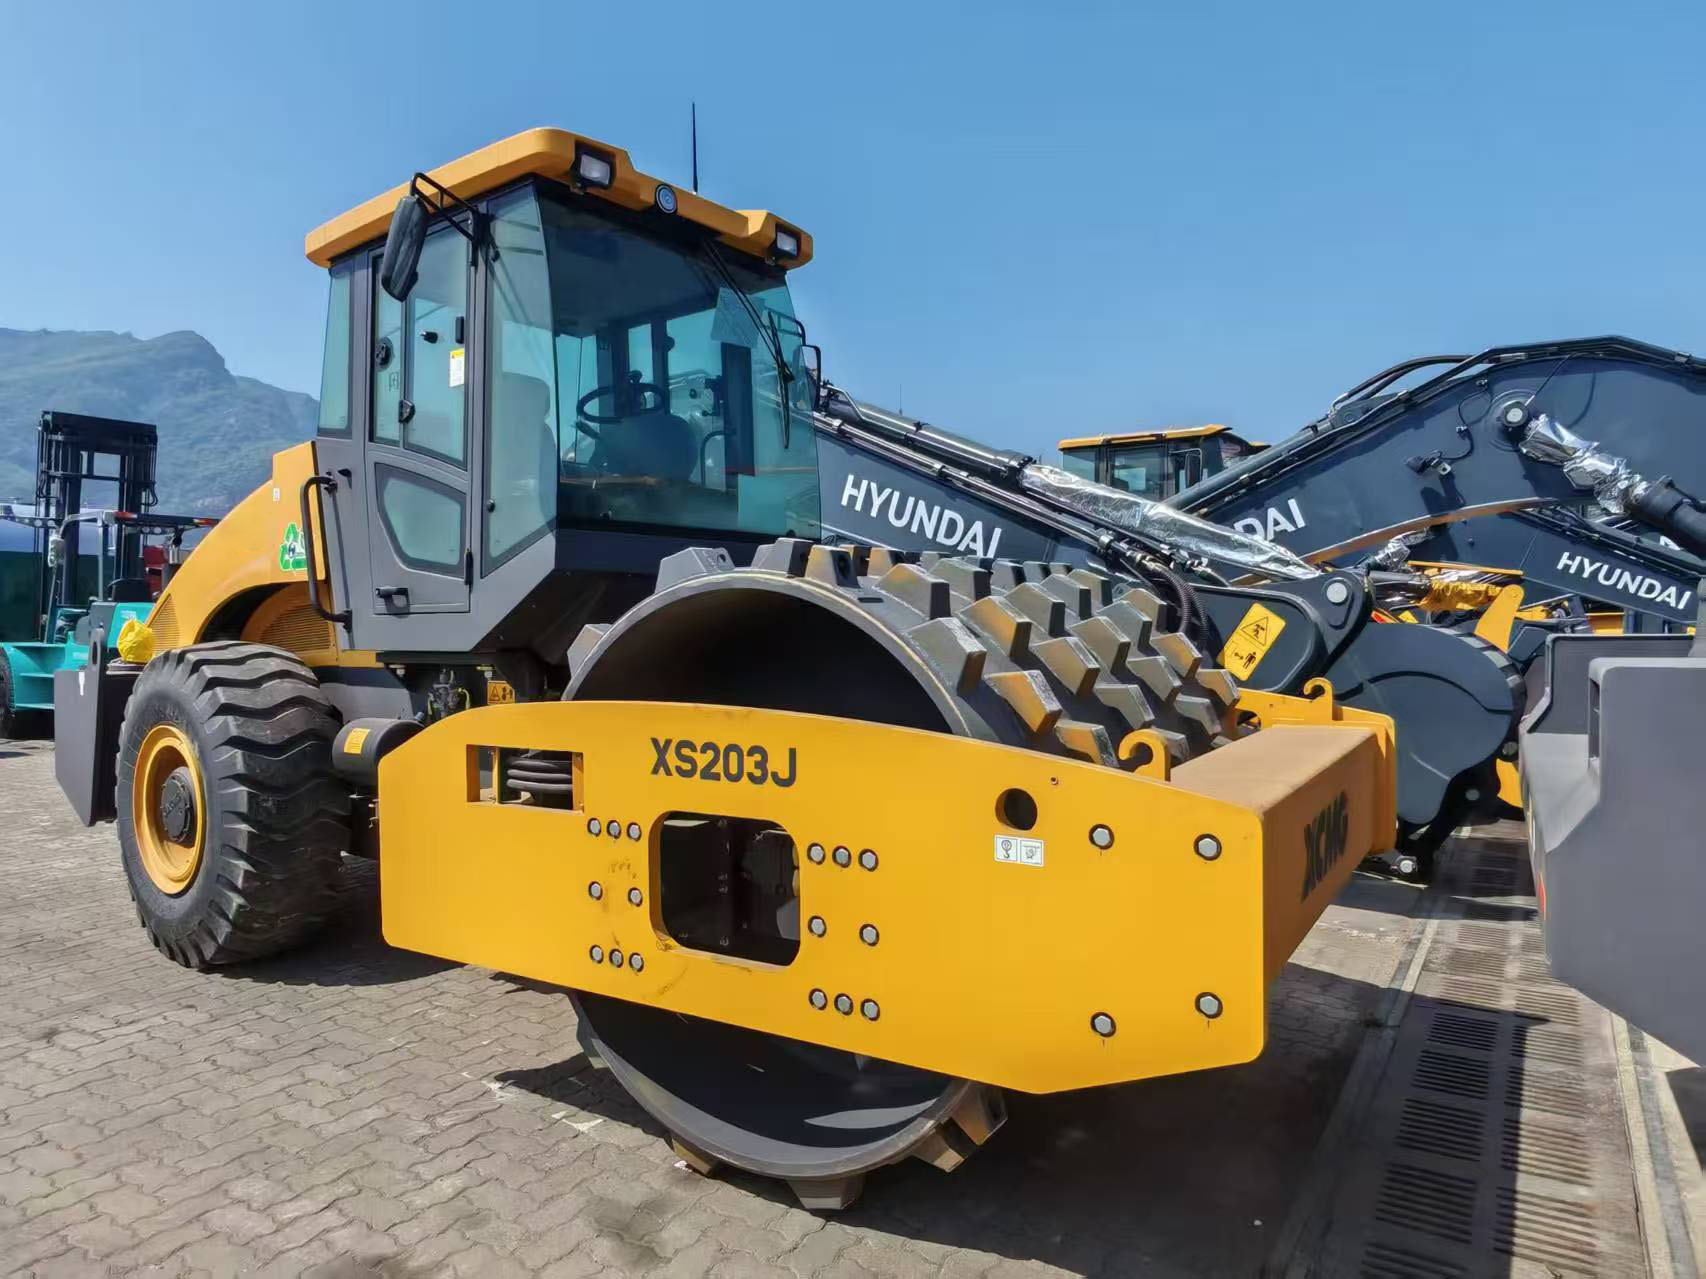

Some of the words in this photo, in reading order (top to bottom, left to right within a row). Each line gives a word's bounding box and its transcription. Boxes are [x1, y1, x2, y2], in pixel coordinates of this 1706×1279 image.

[841, 475, 1002, 559] HYUNDAI
[1557, 552, 1692, 610] HYUNDAI
[650, 737, 797, 788] XS203J
